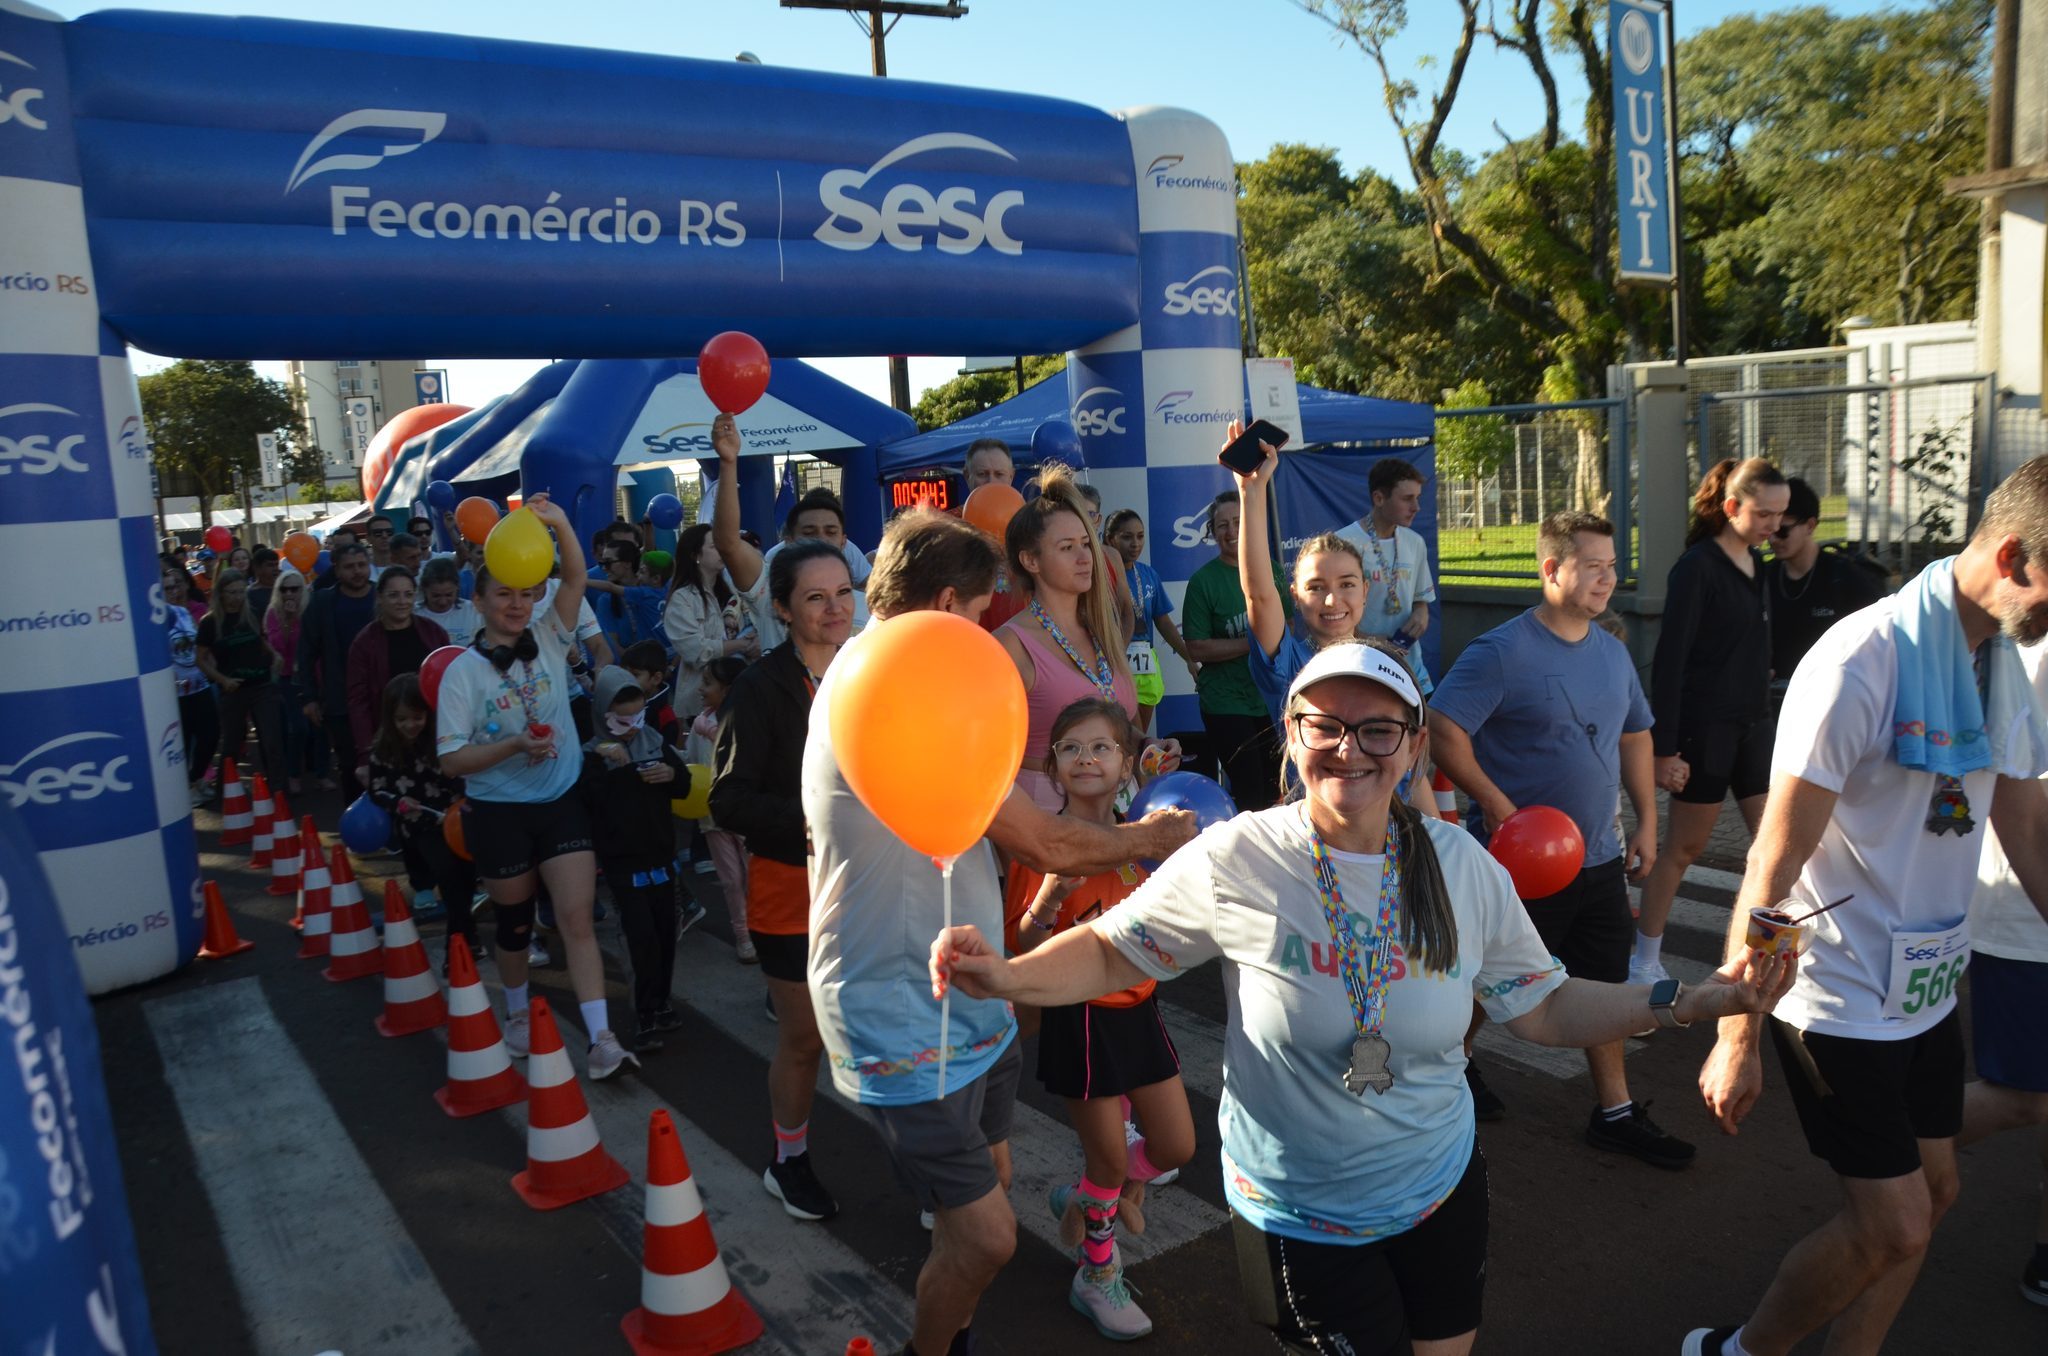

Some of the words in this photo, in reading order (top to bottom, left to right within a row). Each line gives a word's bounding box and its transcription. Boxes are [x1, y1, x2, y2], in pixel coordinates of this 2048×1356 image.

[1624, 86, 1658, 269] URI
[330, 185, 662, 246] Fecomércio
[678, 200, 747, 248] RS
[813, 168, 1025, 256] Sesc
[57, 274, 89, 296] RS
[642, 434, 713, 455] Ses
[98, 603, 126, 625] RS
[143, 910, 170, 933] RS
[1904, 946, 1941, 962] Sesc
